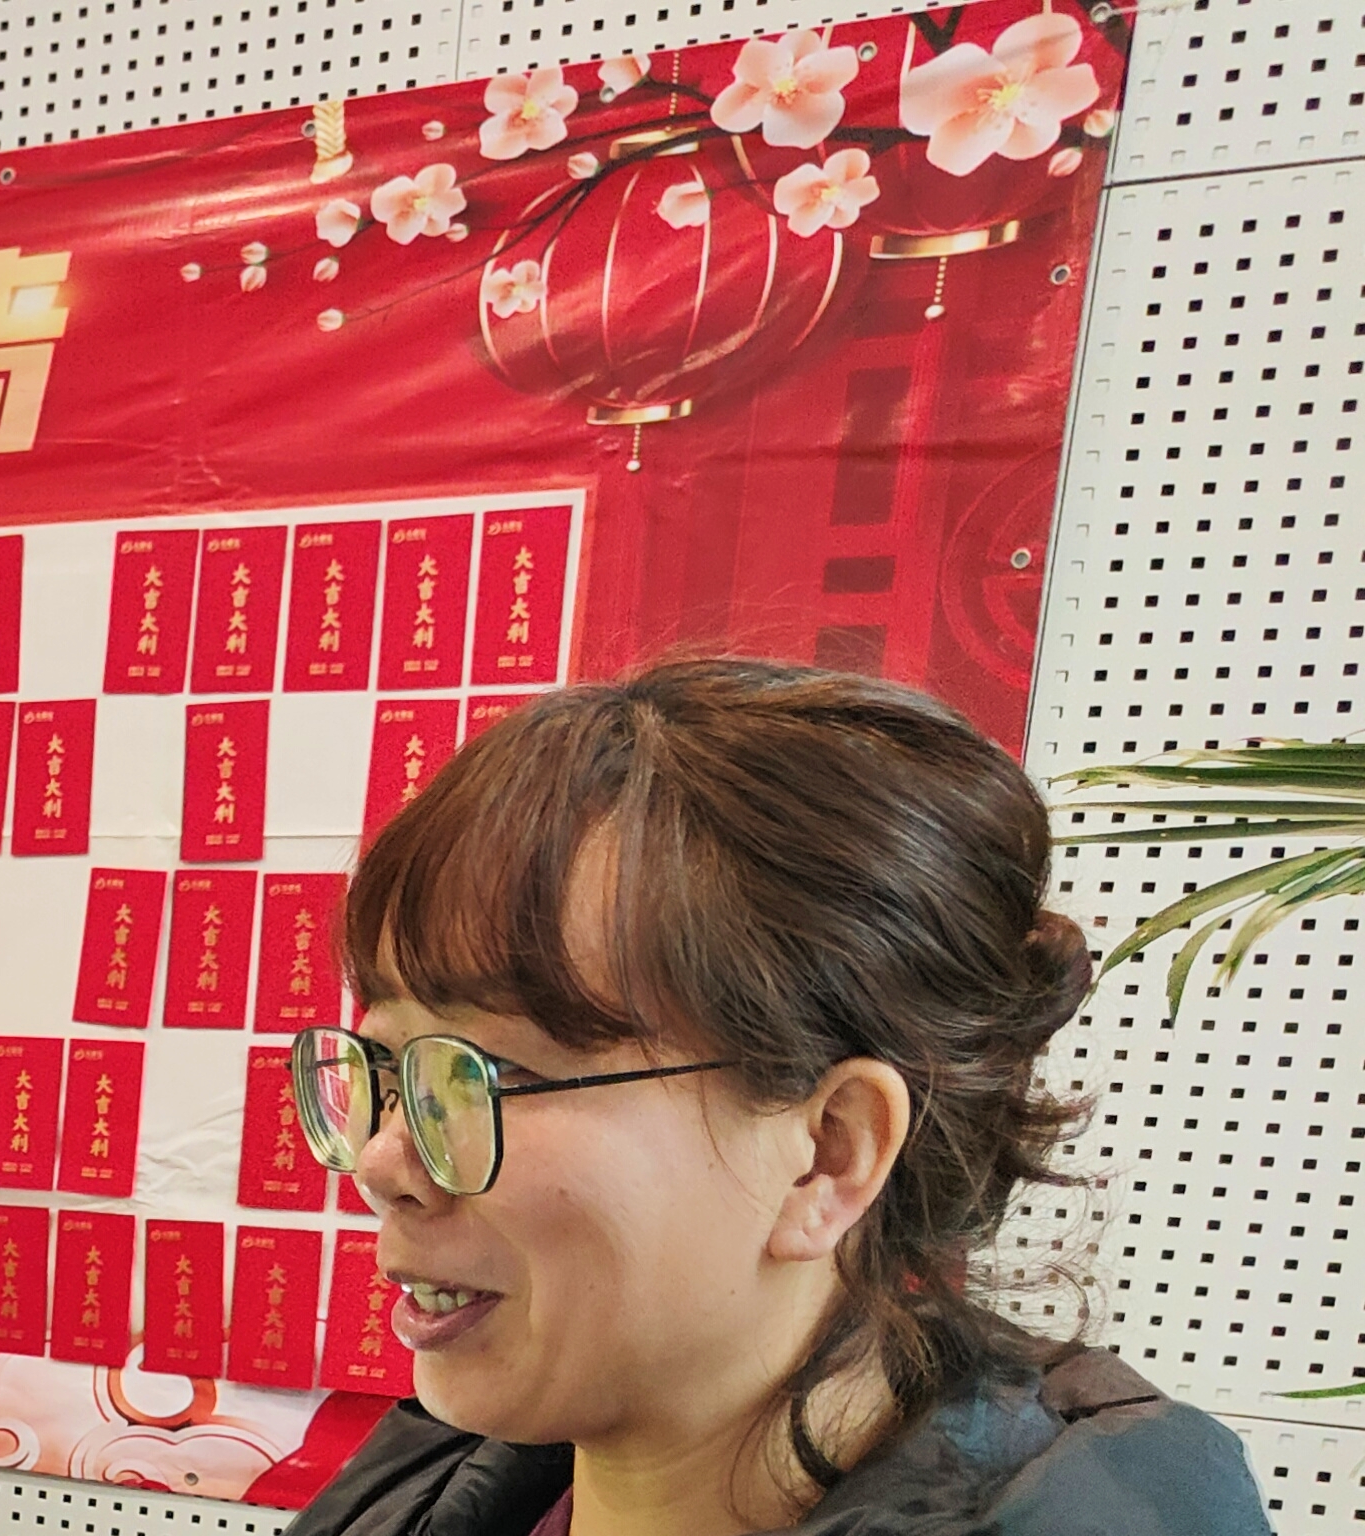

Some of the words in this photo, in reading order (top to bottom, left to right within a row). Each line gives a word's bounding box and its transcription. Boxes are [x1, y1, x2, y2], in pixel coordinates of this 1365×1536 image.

[138, 566, 162, 655] 大吉大利
[226, 564, 250, 653] 大吉大利
[319, 559, 344, 651] 大吉大利
[413, 555, 438, 648] 大吉大利
[507, 547, 533, 643] 大吉大利
[43, 734, 64, 817] 大吉大利
[214, 737, 236, 823] 大吉大利
[402, 734, 425, 802] 大吉大
[107, 904, 133, 989] 大吉大利
[197, 905, 222, 991] 大吉大利
[290, 909, 315, 995] 大吉大利
[10, 1070, 32, 1152] 大吉大利
[90, 1074, 113, 1157] 大吉大利
[82, 1246, 102, 1327] 大吉大利
[263, 1263, 286, 1348] 大吉大利
